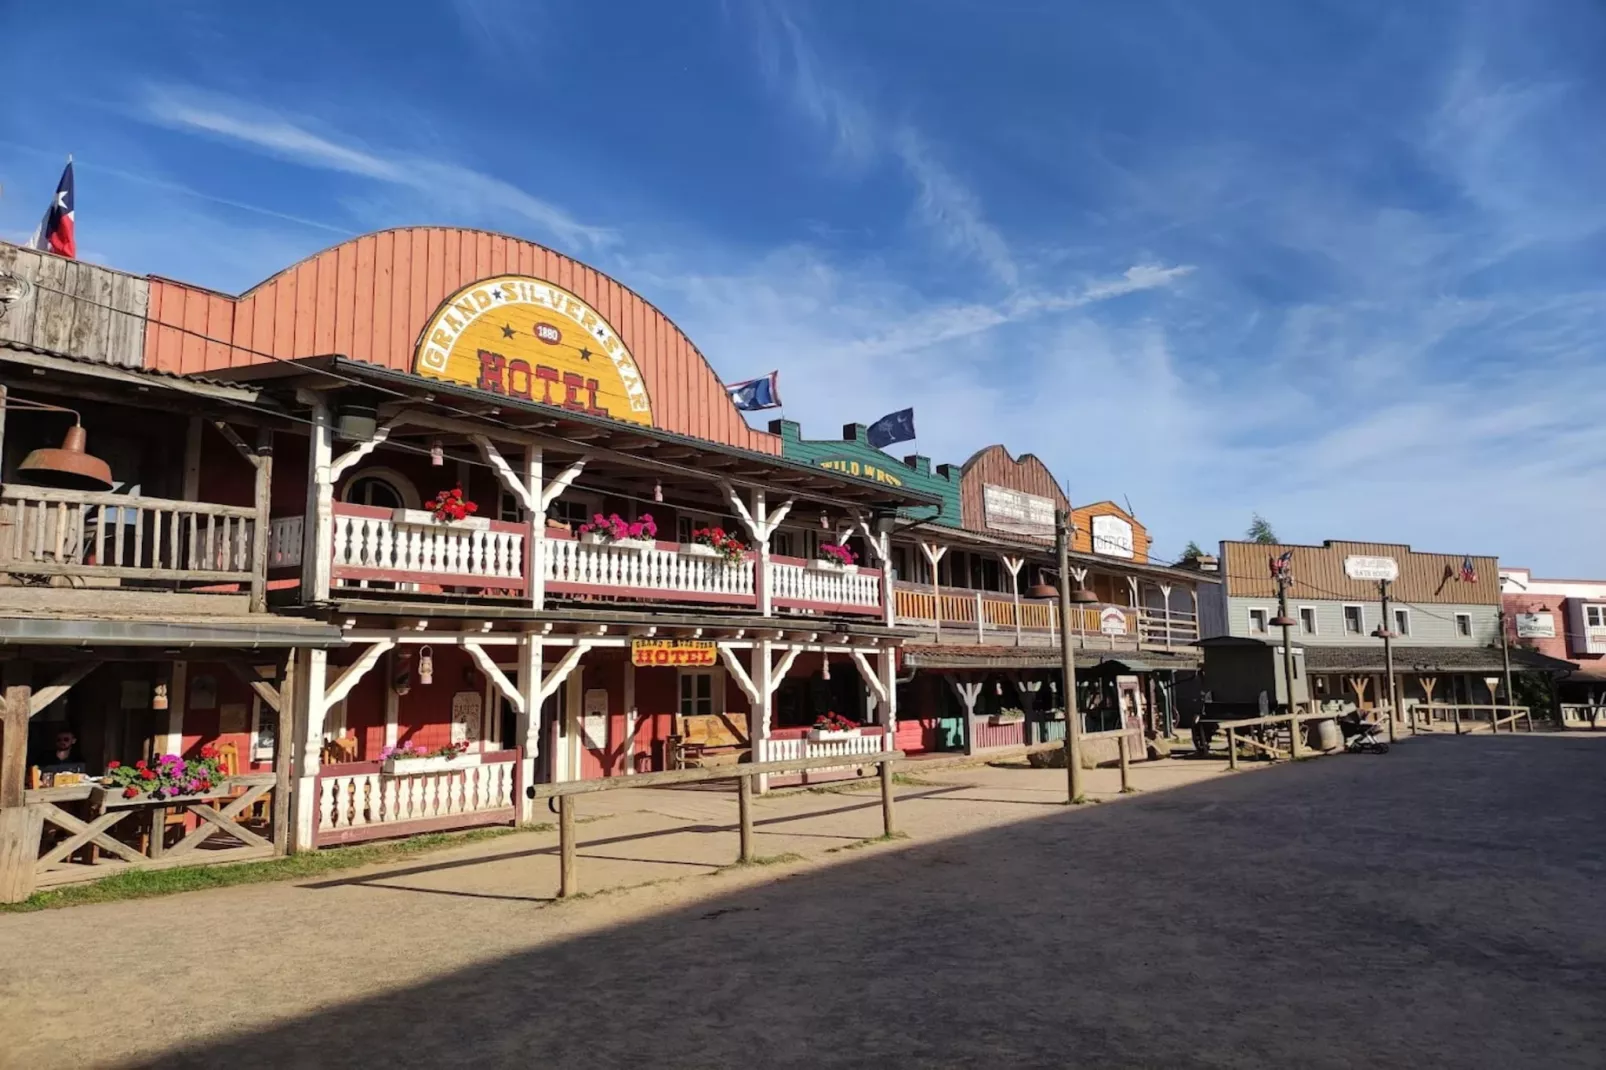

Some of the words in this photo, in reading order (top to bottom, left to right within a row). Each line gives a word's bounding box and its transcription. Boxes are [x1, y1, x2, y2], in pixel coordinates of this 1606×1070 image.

[425, 290, 491, 368] GRAND
[501, 282, 597, 332] SILVER
[603, 336, 646, 410] STAR
[537, 325, 557, 341] 1880
[477, 349, 607, 418] HOTEL
[636, 650, 713, 664] HOTEL
